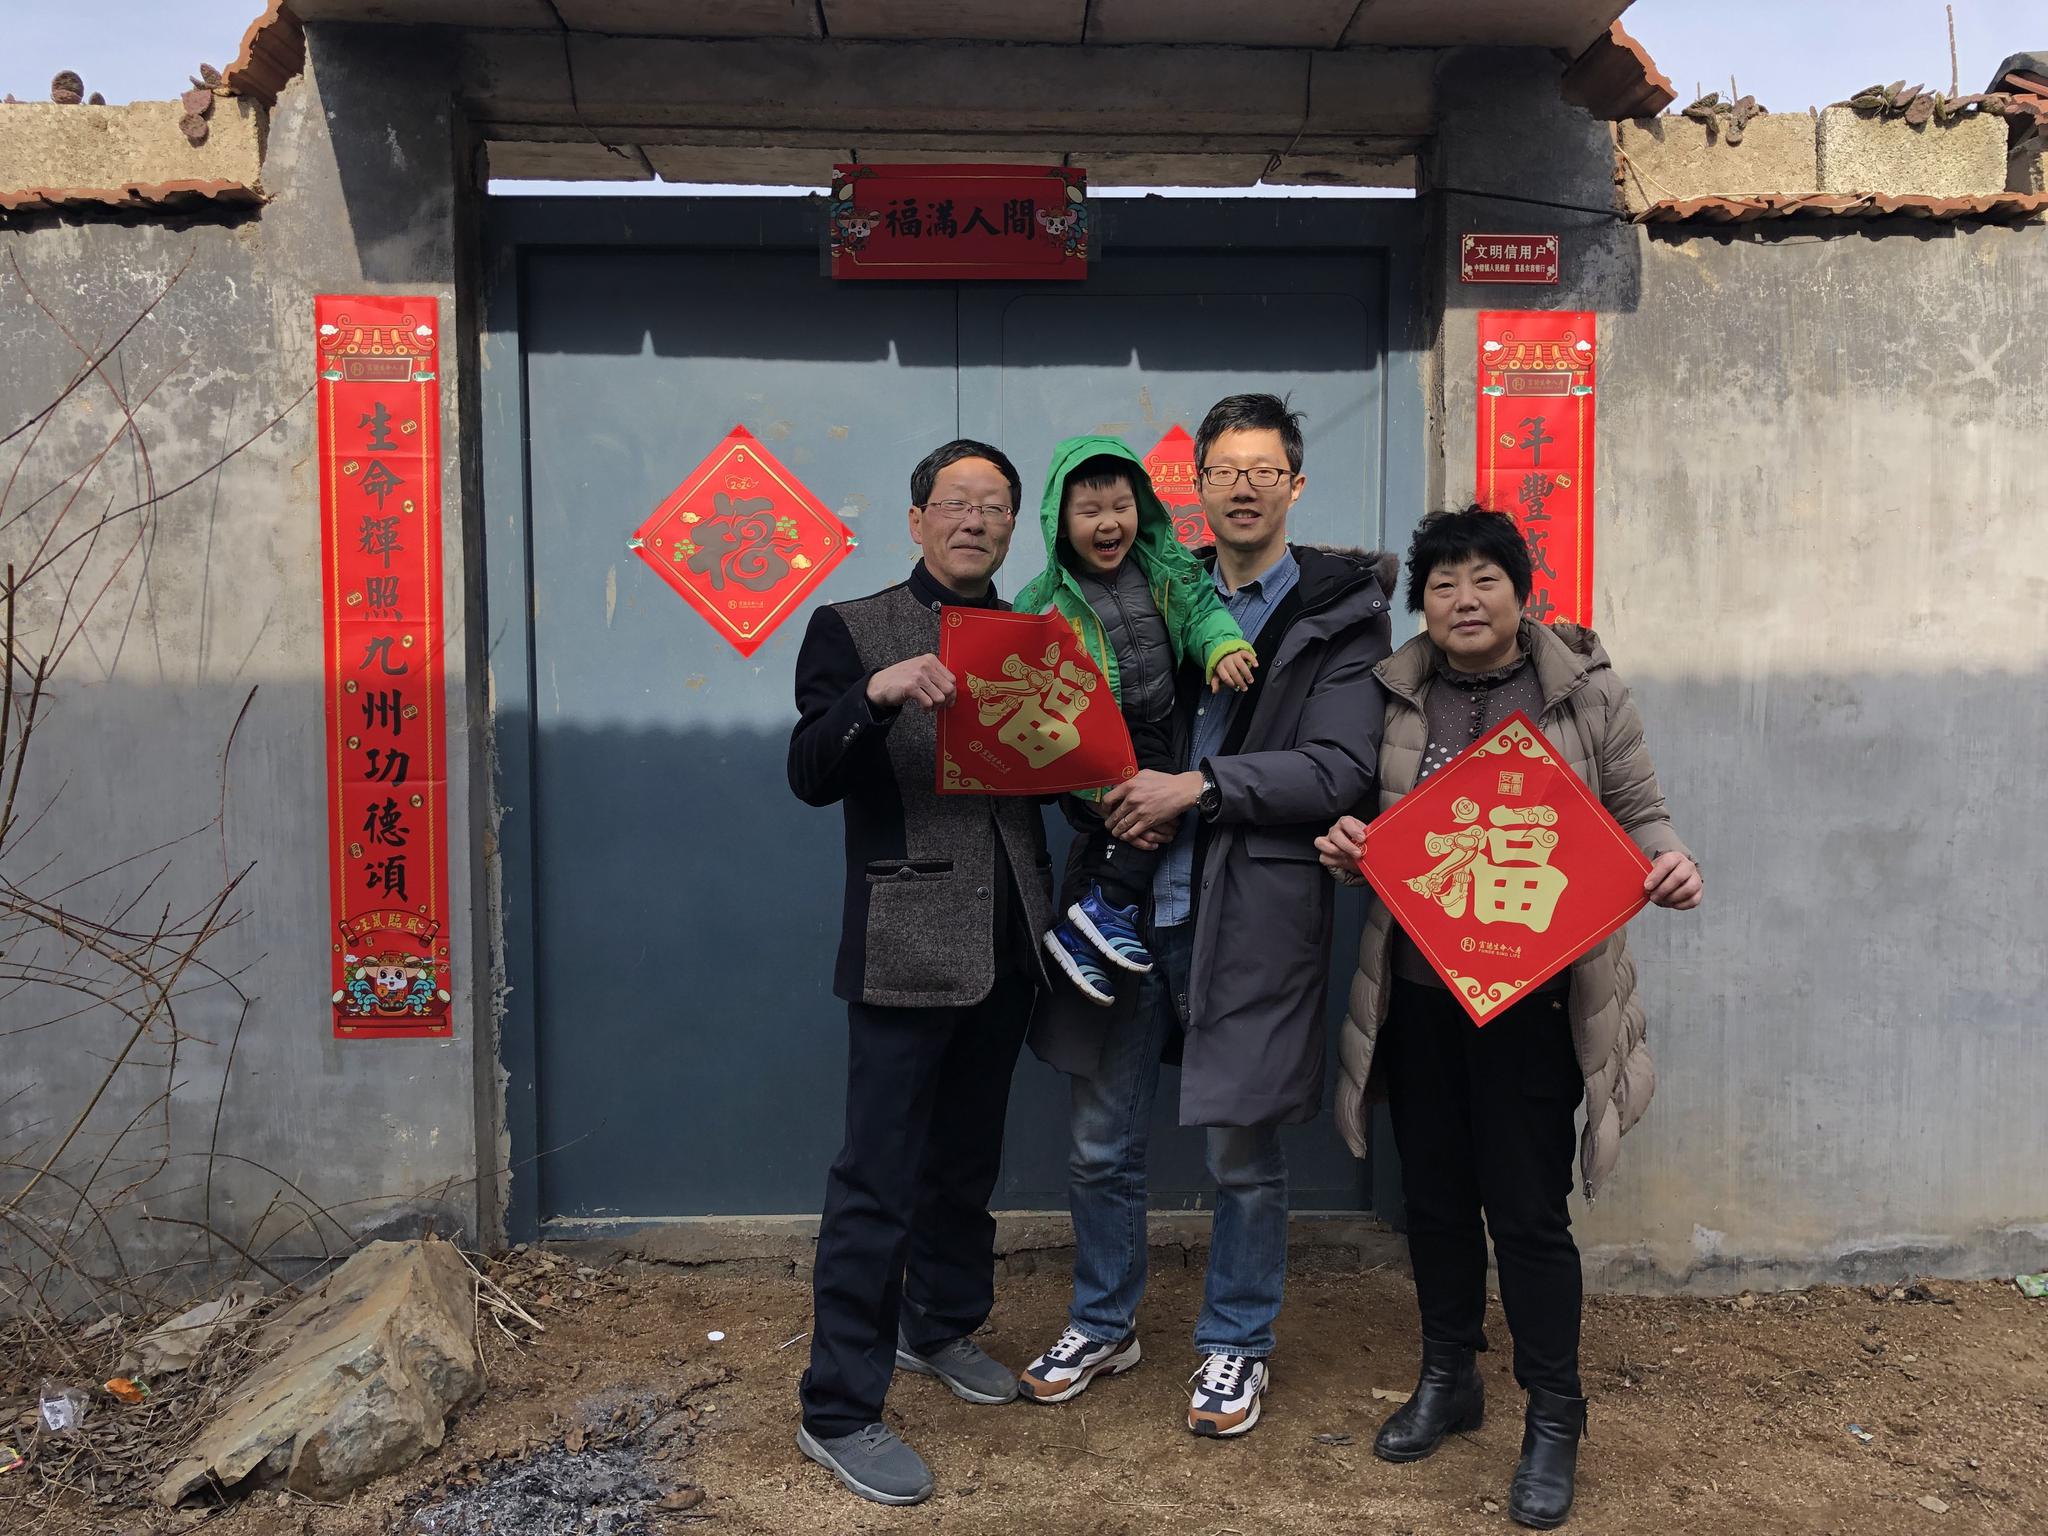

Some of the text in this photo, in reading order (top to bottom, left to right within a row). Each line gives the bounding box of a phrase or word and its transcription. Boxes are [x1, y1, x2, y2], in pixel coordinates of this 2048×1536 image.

[1474, 245, 1547, 260] 文明信用户
[965, 641, 1097, 769] 福
[1401, 796, 1569, 933] 福
